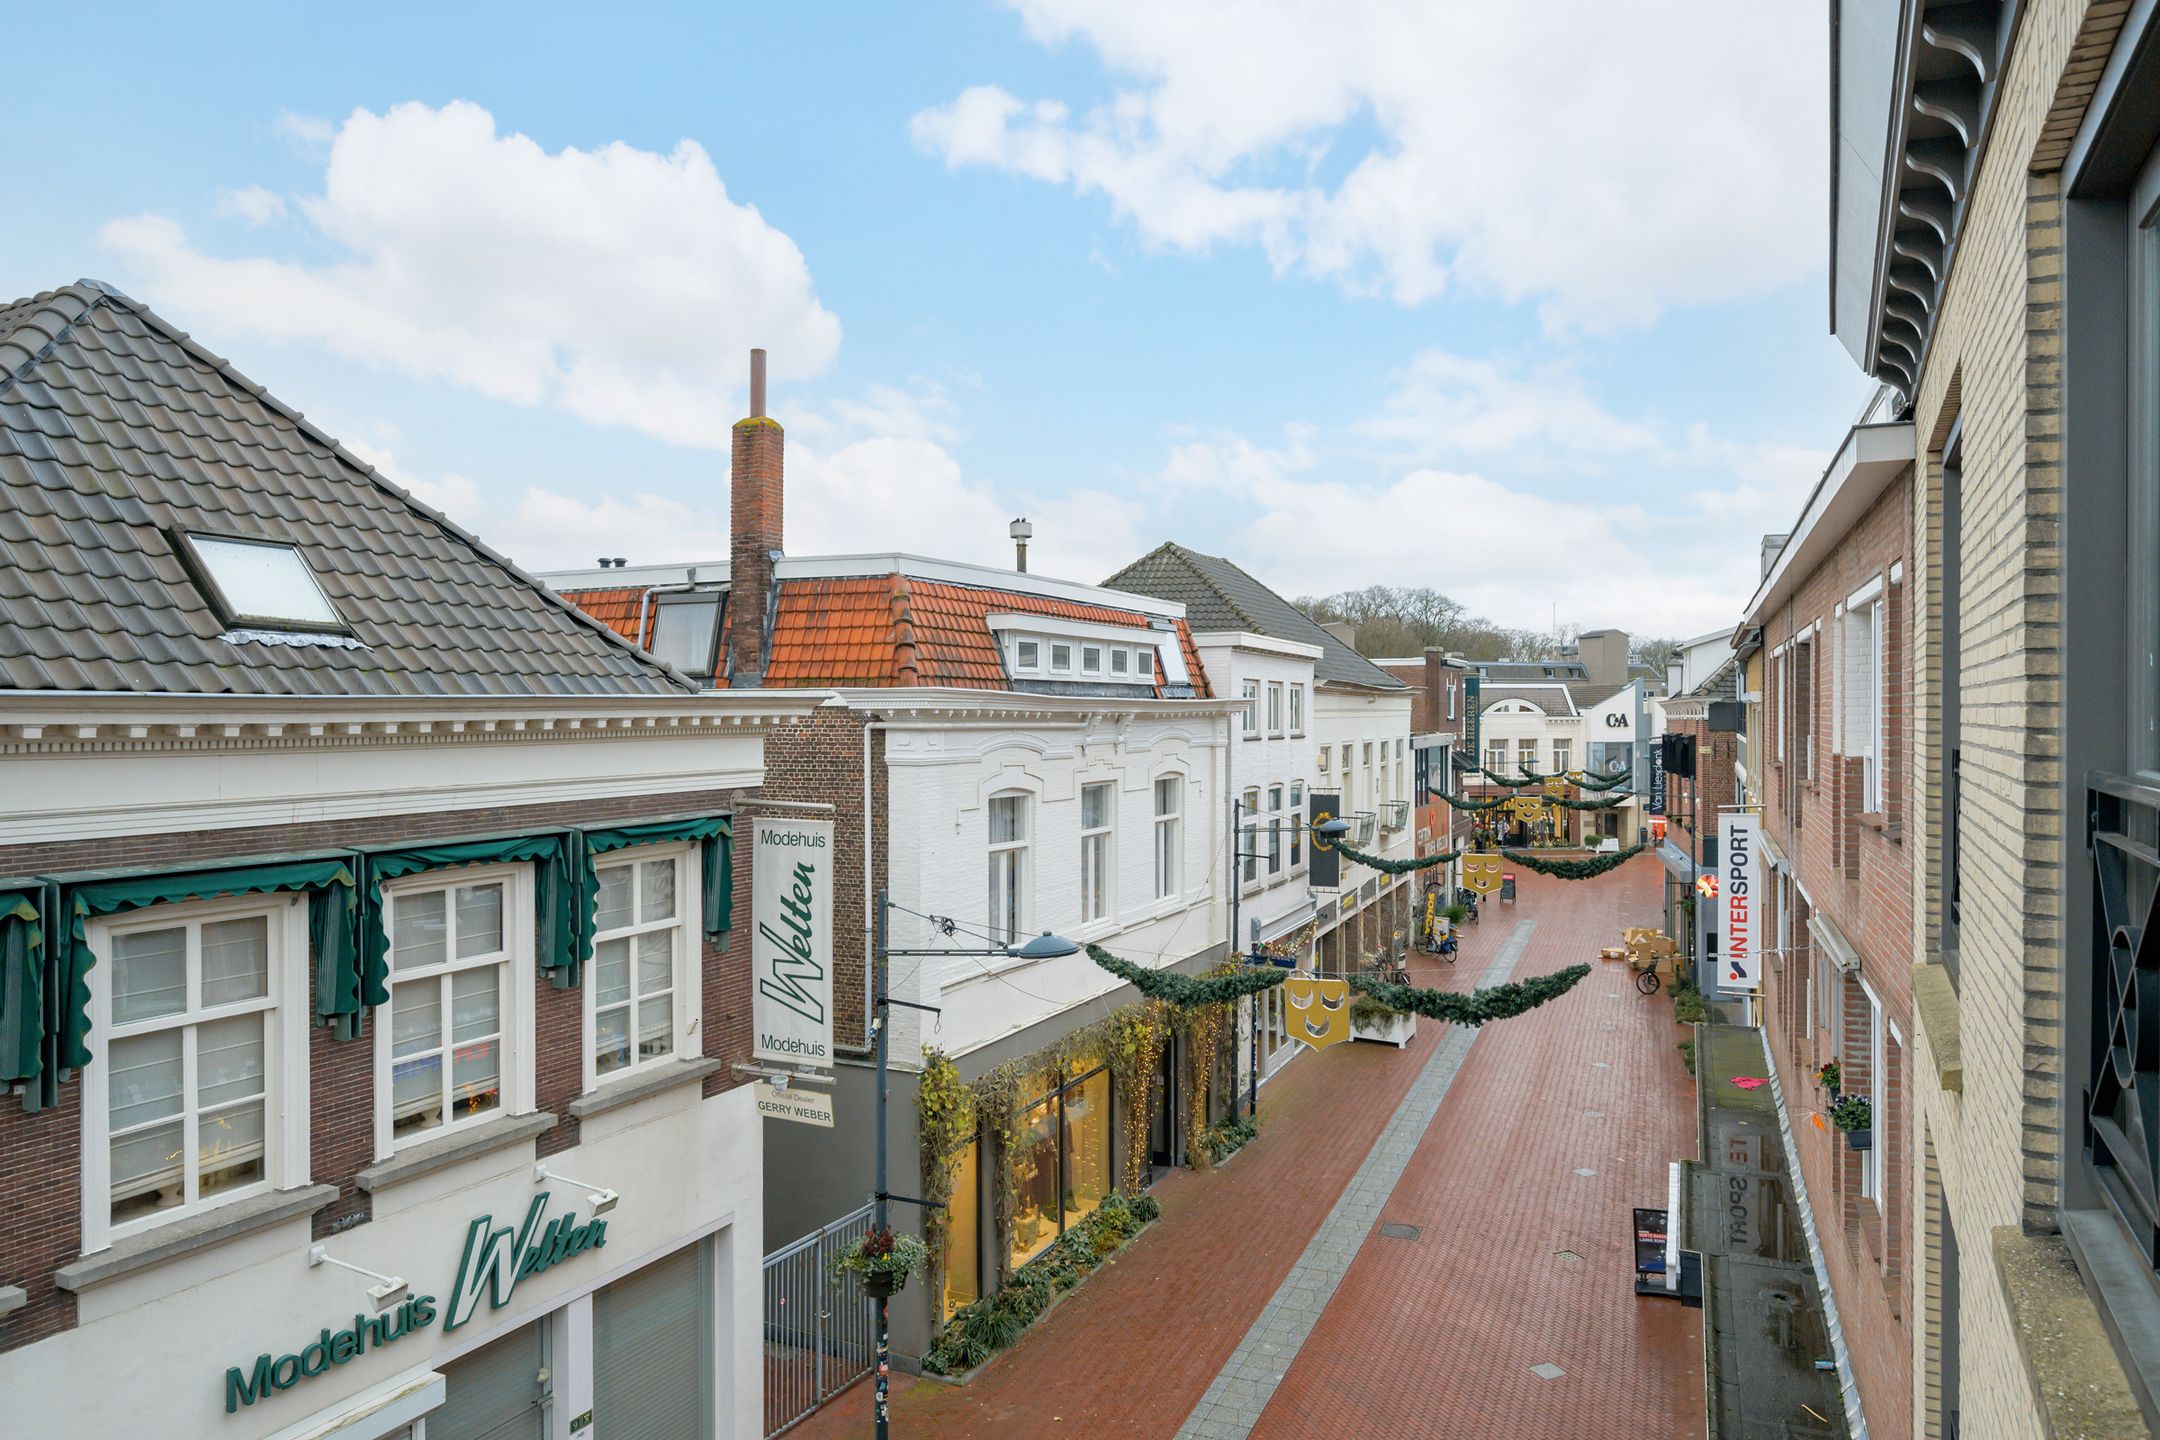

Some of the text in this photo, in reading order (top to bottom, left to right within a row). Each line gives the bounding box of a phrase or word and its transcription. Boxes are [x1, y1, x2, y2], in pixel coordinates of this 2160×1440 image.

[1606, 713, 1629, 728] C&A
[1609, 758, 1626, 774] C&A
[1652, 749, 1663, 810] Van Liesdonk
[761, 829, 825, 848] Modehuis
[1729, 824, 1749, 959] INTERSPORT
[759, 861, 824, 1025] Welten
[761, 1034, 825, 1056] Modehuis
[758, 1100, 831, 1122] GERRY WEBER
[226, 1191, 608, 1413] Modehuis Welten
